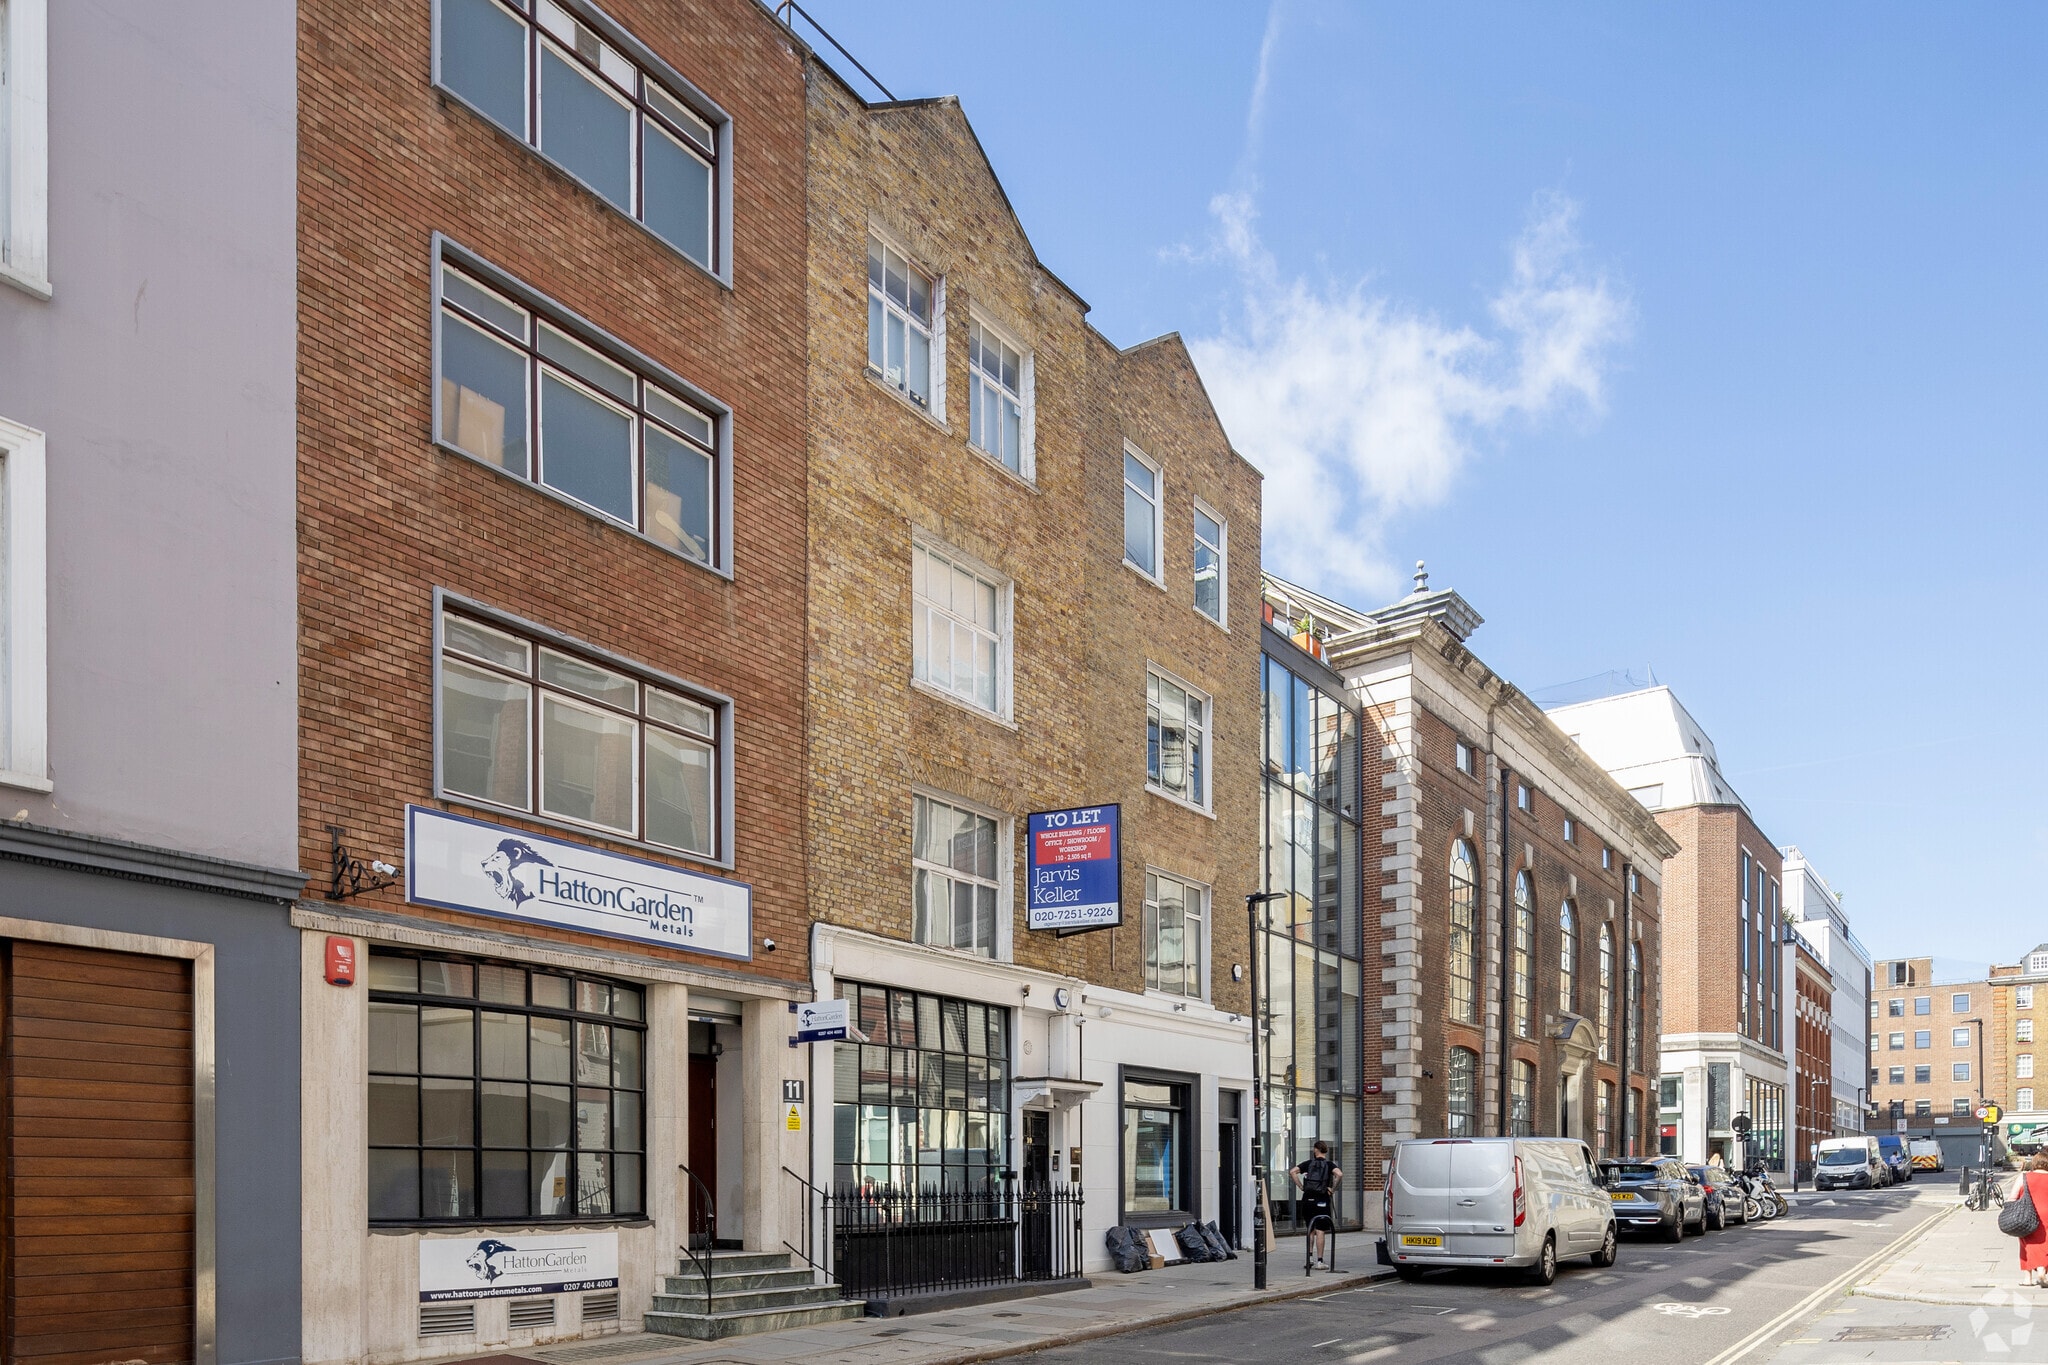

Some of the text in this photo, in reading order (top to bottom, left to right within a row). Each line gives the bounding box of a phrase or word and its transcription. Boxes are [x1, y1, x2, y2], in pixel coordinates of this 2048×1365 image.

[1045, 809, 1101, 828] TO LET
[1040, 831, 1058, 839] WHOLE
[1059, 829, 1082, 838] BUILDING
[1087, 827, 1106, 835] FLOORS
[1044, 839, 1063, 847] OFFICE
[1067, 836, 1097, 845] SHOWROOM
[1059, 845, 1087, 853] WORKSHOP
[1034, 865, 1080, 888] Jarvis
[538, 869, 693, 924] HattonGarden
[1033, 886, 1082, 904] Keller
[1034, 907, 1113, 922] 020-7251-9226
[649, 919, 694, 937] Metals
[786, 1081, 800, 1099] 11
[503, 1251, 587, 1269] HattonGarden
[430, 1279, 613, 1300] www.hattongardenmetals.com 0207 404 4000
